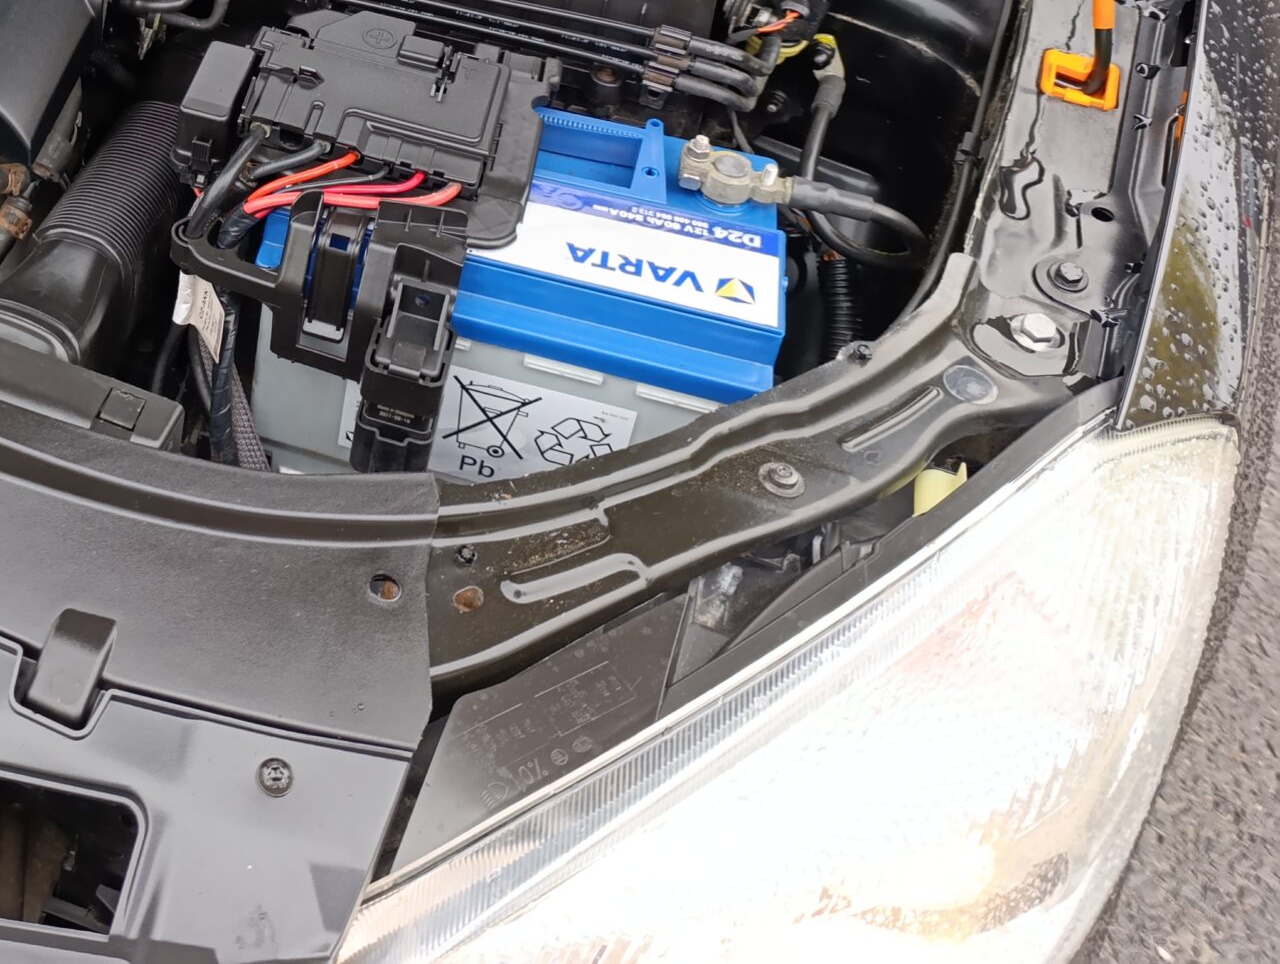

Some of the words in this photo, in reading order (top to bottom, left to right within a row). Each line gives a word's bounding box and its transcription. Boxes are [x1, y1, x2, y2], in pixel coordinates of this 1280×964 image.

[683, 224, 709, 237] 12V
[712, 226, 762, 248] D24
[566, 242, 704, 292] VARTA
[459, 454, 496, 478] Pb
